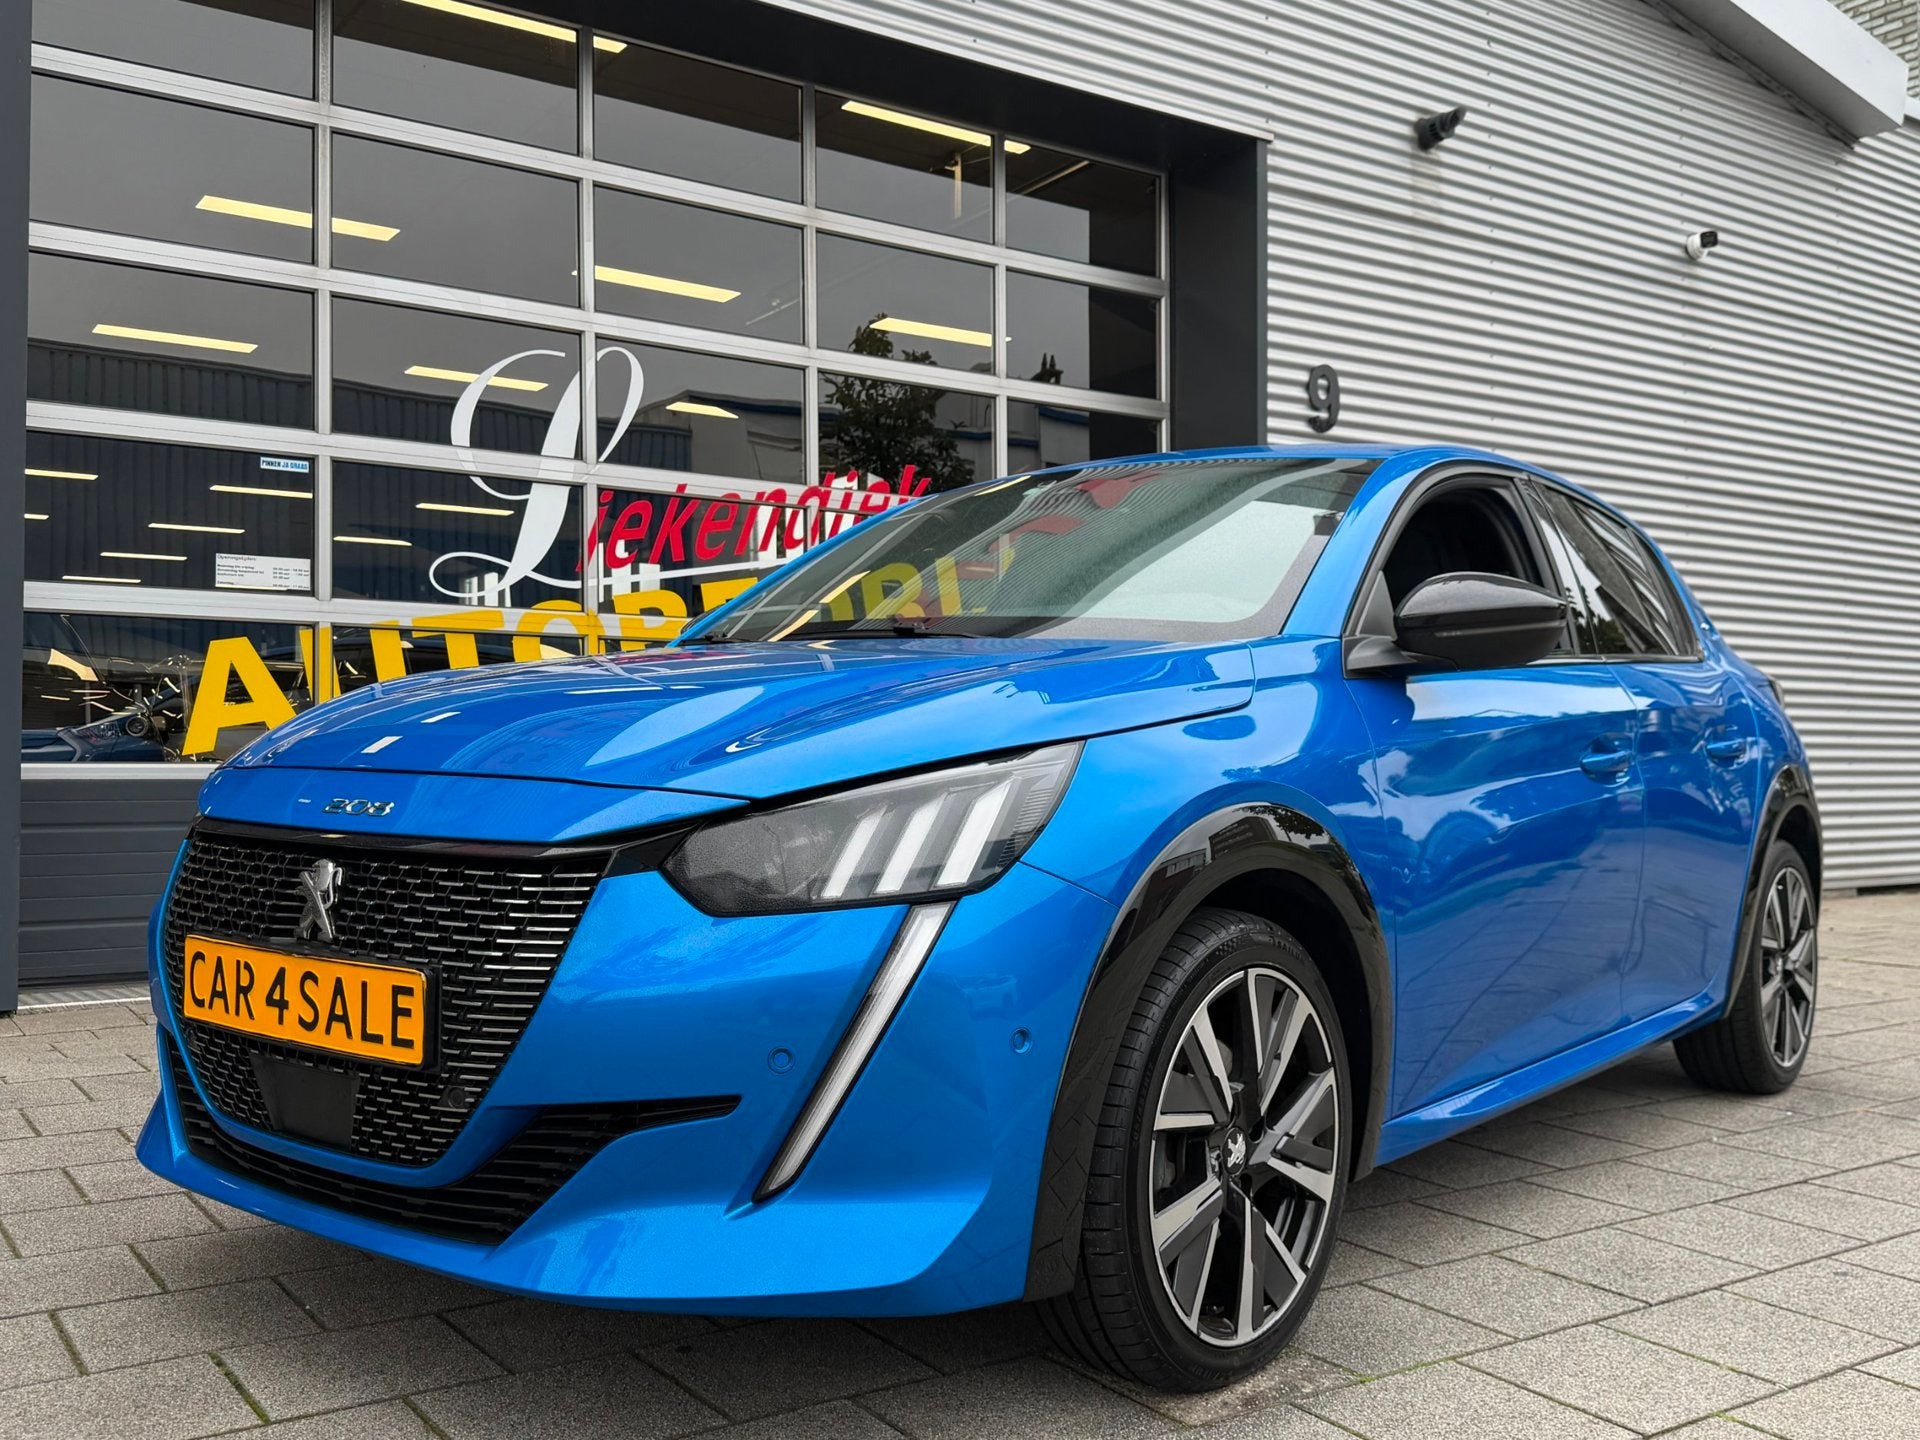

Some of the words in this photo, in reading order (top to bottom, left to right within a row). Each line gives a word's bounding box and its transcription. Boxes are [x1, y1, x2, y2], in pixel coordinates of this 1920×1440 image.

[1306, 364, 1340, 433] 9
[322, 798, 394, 817] 208
[190, 951, 255, 1020] CAR
[265, 966, 289, 1025] 4
[298, 971, 414, 1049] SALE
